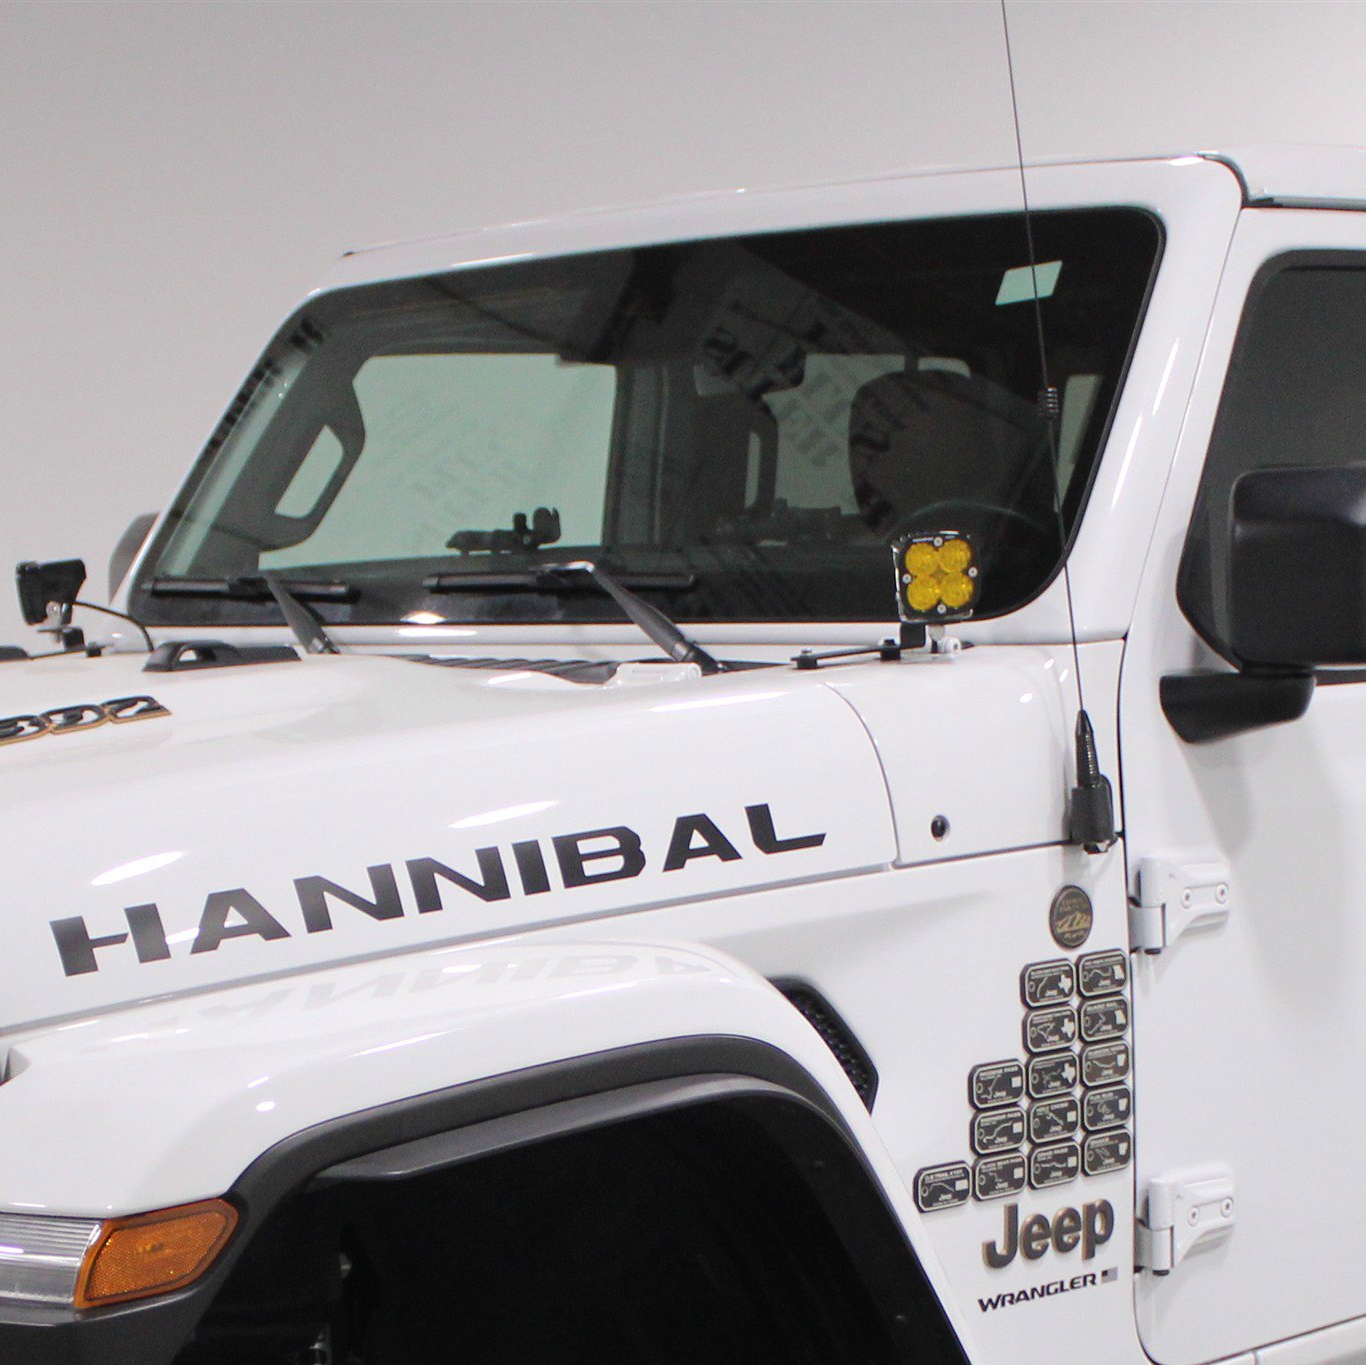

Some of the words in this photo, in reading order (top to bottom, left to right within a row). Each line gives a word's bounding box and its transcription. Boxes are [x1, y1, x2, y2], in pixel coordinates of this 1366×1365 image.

[49, 803, 826, 977] HANNIBAL
[982, 1199, 1114, 1268] Jeep
[977, 1273, 1097, 1312] WRANGLER
